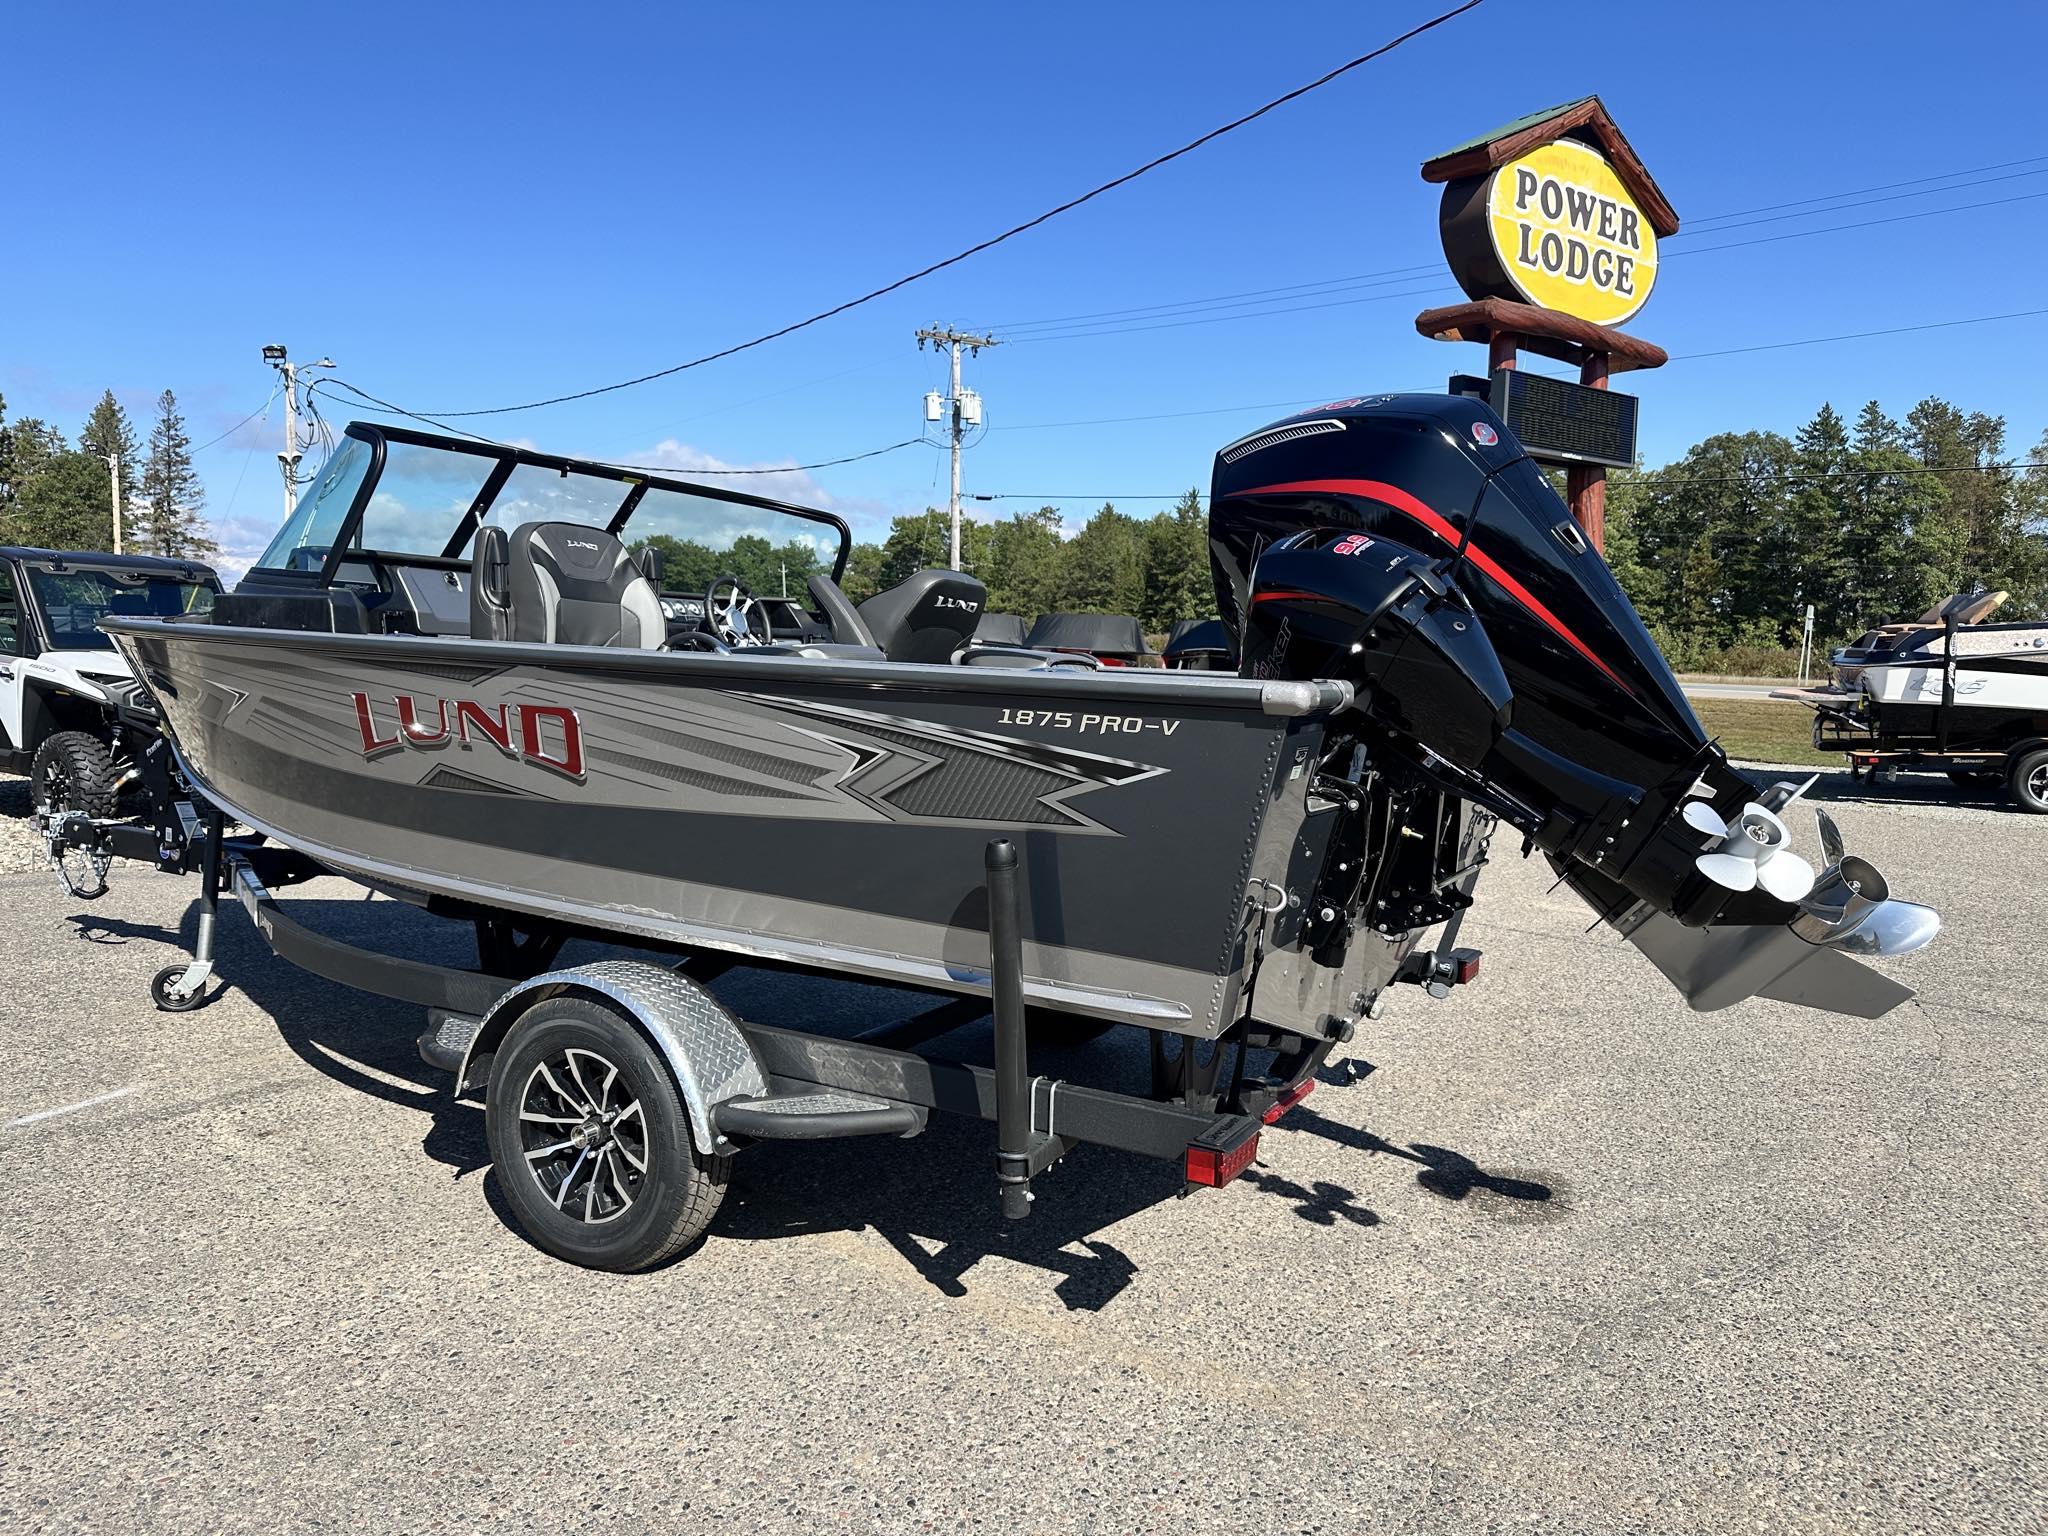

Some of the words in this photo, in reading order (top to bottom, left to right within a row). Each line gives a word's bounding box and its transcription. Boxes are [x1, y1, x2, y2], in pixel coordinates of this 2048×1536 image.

[1516, 168, 1640, 250] POWER
[1518, 223, 1635, 296] LODGE
[566, 539, 599, 551] LUND
[1333, 535, 1370, 555] 9.9
[934, 595, 979, 613] LUND
[29, 663, 56, 673] 1500
[997, 708, 1073, 728] 1875
[1078, 714, 1181, 736] PRO-V
[350, 692, 588, 781] LUND
